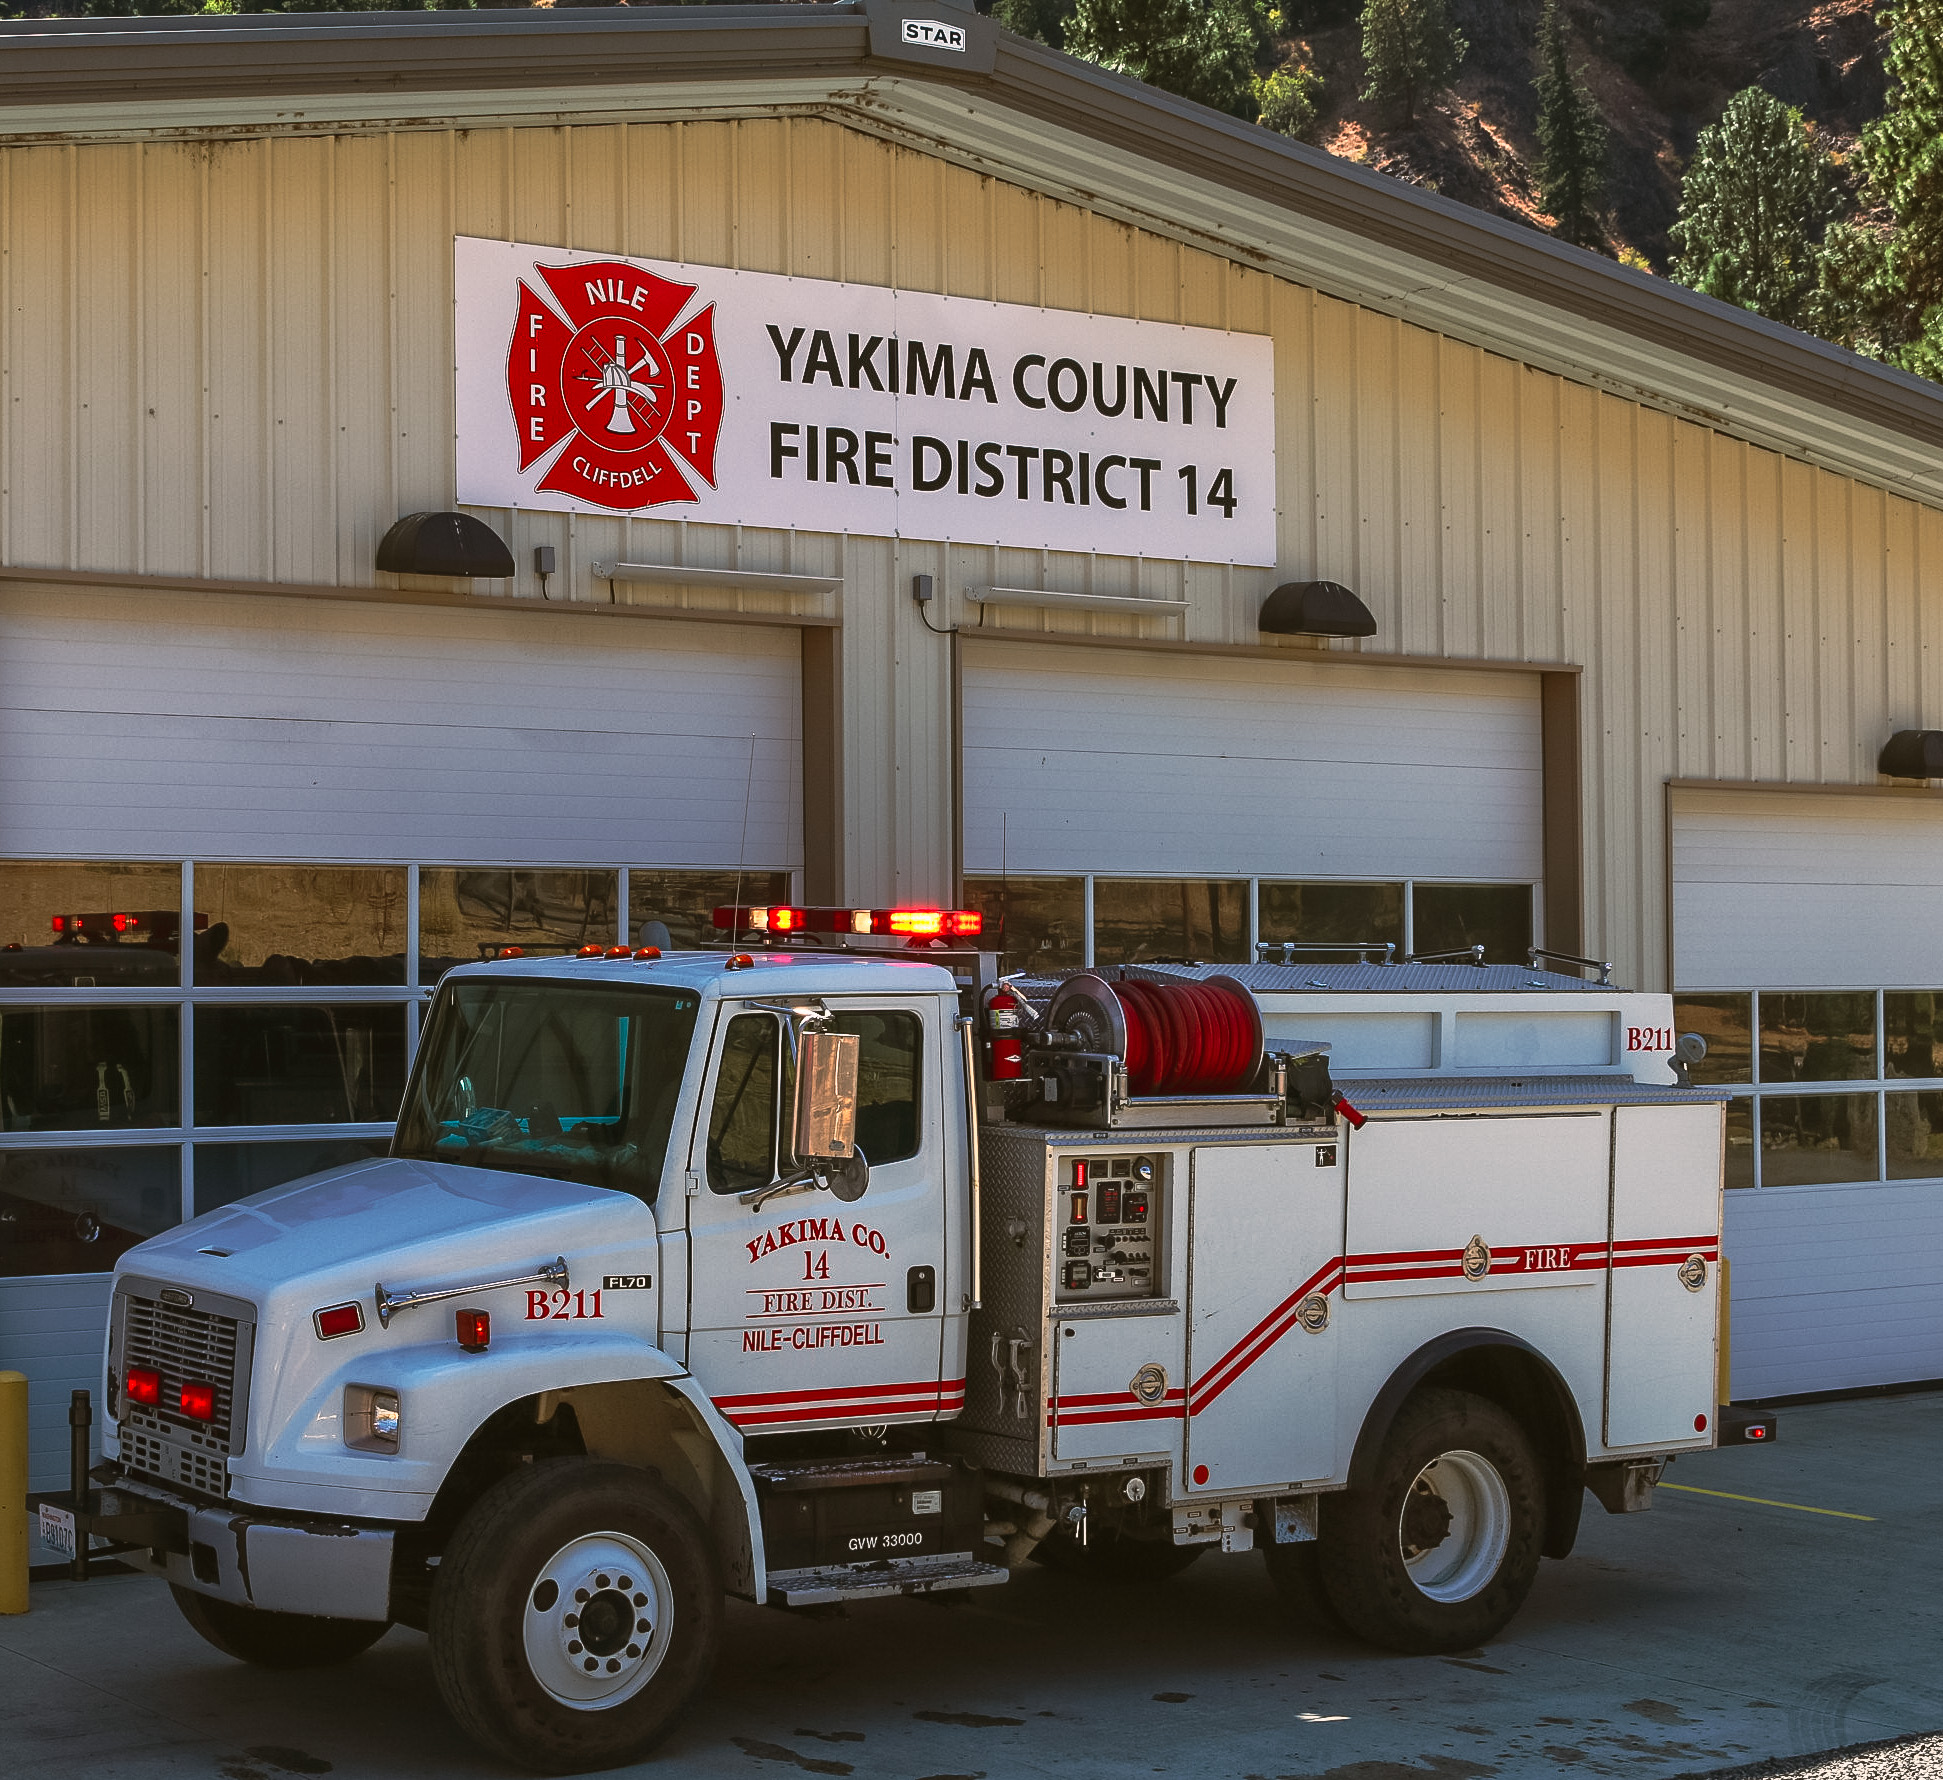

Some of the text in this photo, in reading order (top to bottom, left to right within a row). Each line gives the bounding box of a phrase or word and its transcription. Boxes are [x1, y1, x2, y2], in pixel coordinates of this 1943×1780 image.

[906, 23, 962, 46] STAR
[584, 278, 649, 312] NILE
[529, 313, 546, 442] FIRE
[765, 324, 1238, 429] YAKIMA COUNTY
[685, 332, 705, 454] DEPT
[572, 455, 663, 489] CLIFFDELL
[769, 421, 1238, 519] FIRE DISTRICT 14
[1626, 1026, 1673, 1052] B211
[745, 1217, 891, 1264] YAKIMA CO.
[802, 1250, 830, 1280] 14
[1523, 1247, 1571, 1270] FIRE
[609, 1276, 646, 1289] FL70
[524, 1288, 605, 1320] B211
[762, 1288, 873, 1313] FIRE DIST.
[742, 1323, 885, 1352] NILE-CLIFFDELL
[848, 1532, 923, 1551] GVW 33000
